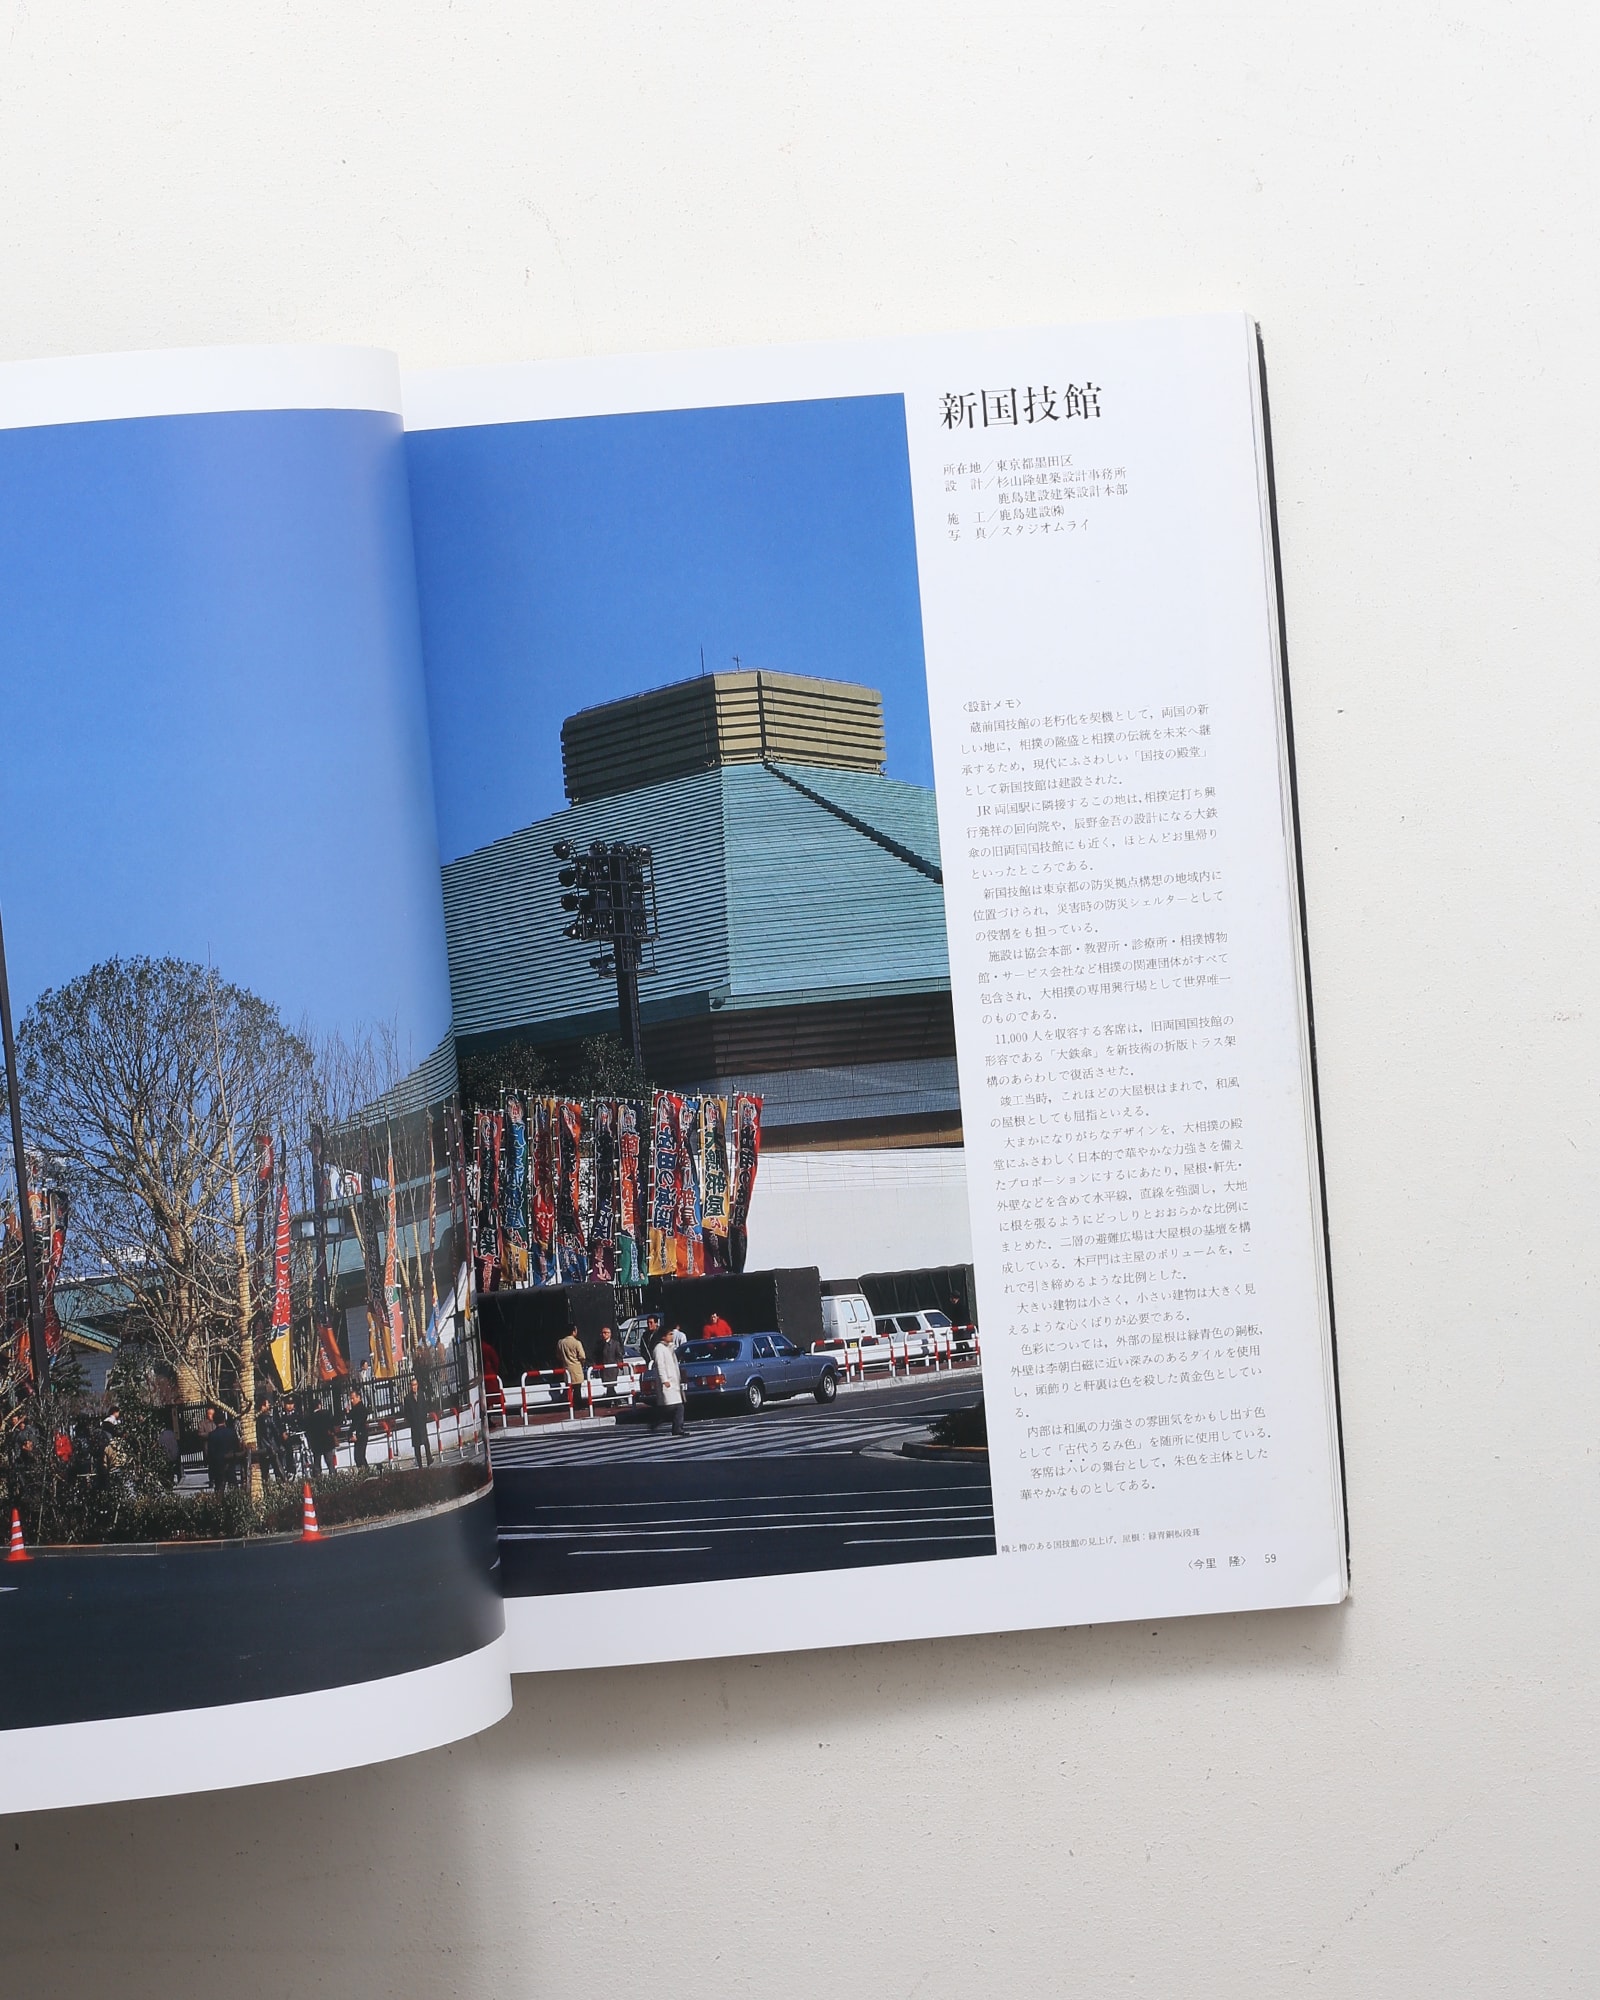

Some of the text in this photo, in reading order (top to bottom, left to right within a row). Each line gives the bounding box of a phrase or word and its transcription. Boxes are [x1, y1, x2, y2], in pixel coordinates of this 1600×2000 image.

[938, 381, 1102, 430] 新国技館
[998, 483, 1128, 505] 鹿島建設建築設計本部
[1264, 1553, 1277, 1564] 59
